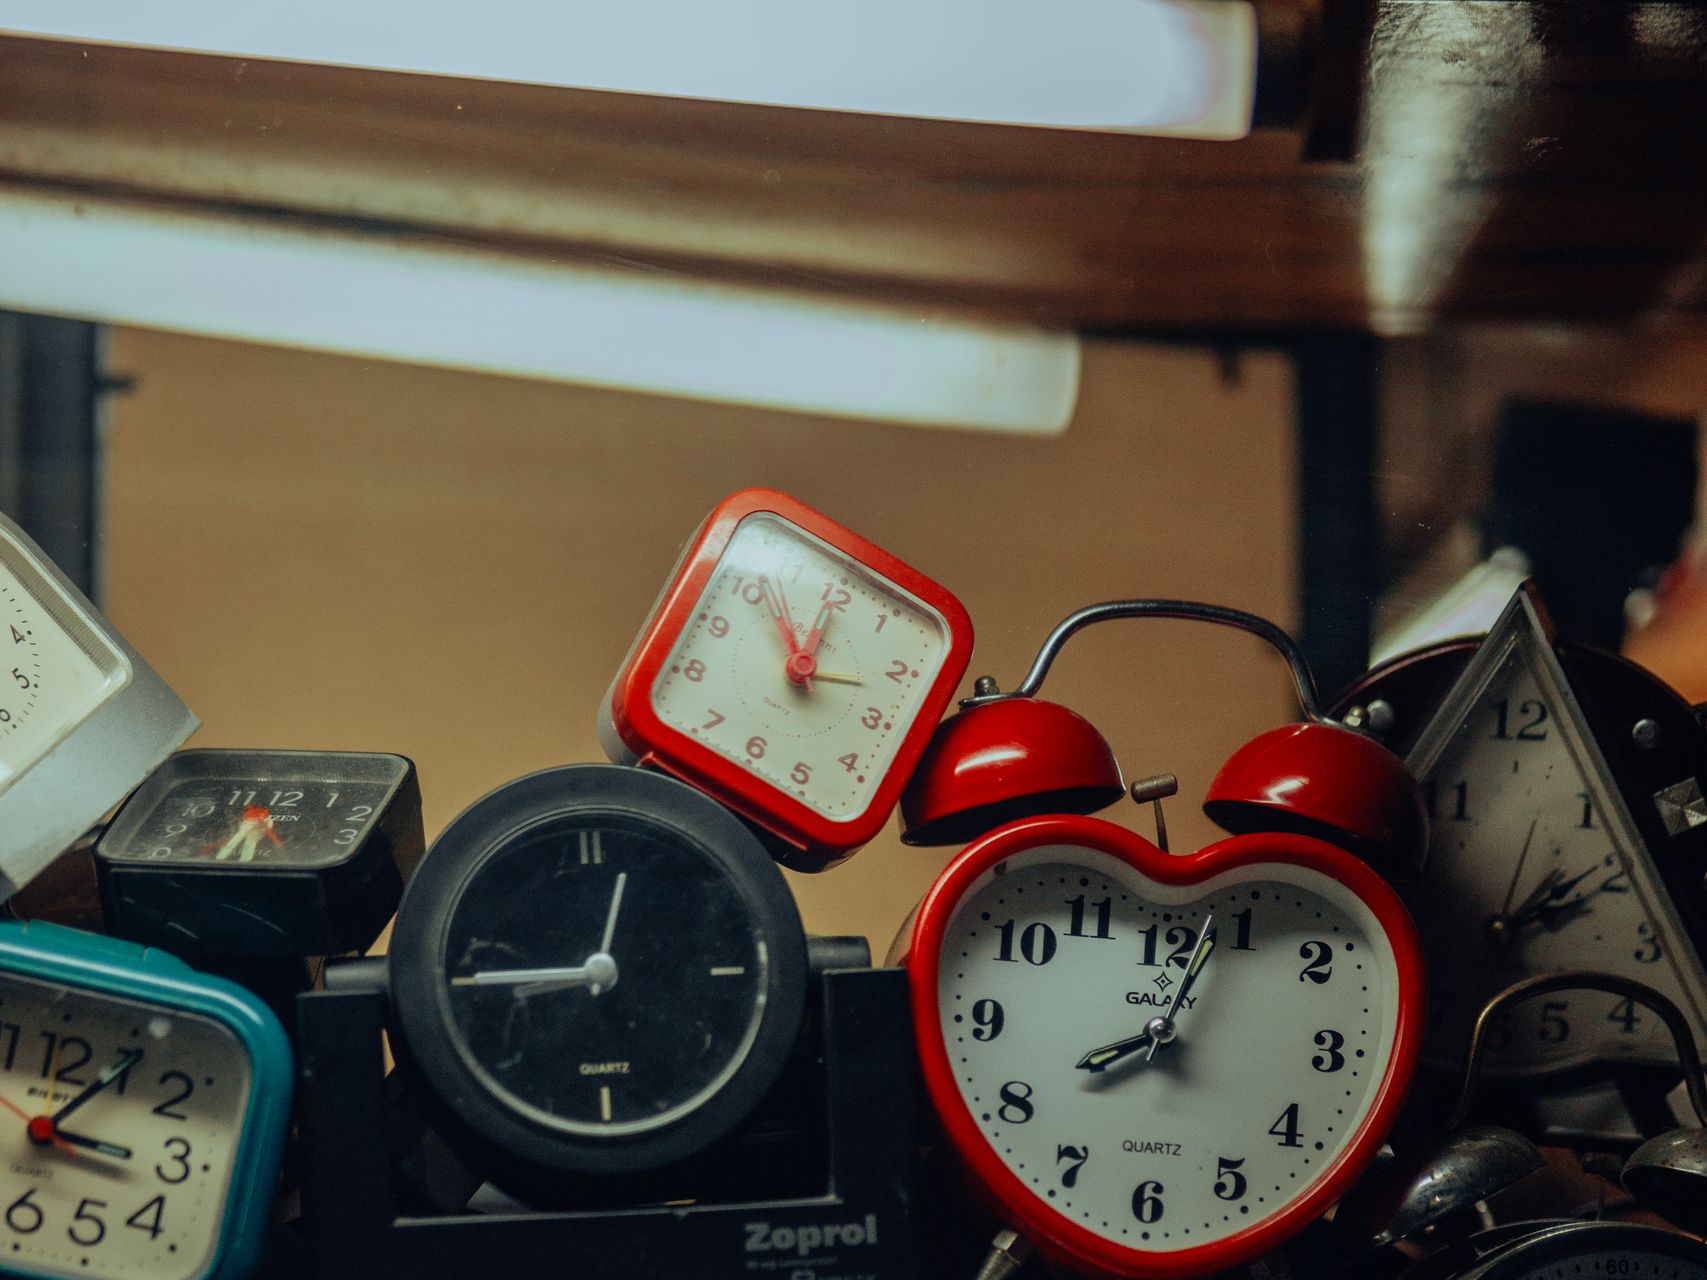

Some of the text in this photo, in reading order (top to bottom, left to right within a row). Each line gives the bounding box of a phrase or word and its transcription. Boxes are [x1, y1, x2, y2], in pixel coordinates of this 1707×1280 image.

[731, 575, 765, 605] 10
[820, 581, 853, 613] 12
[10, 624, 26, 644] 4
[708, 615, 730, 639] 9
[873, 613, 889, 634] 1
[11, 667, 30, 689] 5
[683, 658, 707, 682] 8
[885, 659, 908, 684] 2
[701, 708, 726, 731] 7
[861, 707, 884, 730] 3
[1491, 699, 1548, 741] 12
[745, 735, 768, 760] 6
[838, 752, 859, 773] 4
[790, 762, 814, 785] 5
[228, 790, 257, 806] 11
[269, 791, 304, 807] 12
[326, 792, 339, 808] 1
[345, 805, 372, 821] 2
[1575, 790, 1600, 829] 1
[165, 824, 187, 838] 9
[333, 828, 358, 844] 3
[1063, 893, 1117, 940] 11
[1230, 907, 1257, 951] 1
[992, 918, 1057, 966] 10
[1136, 924, 1199, 970] 12
[1633, 920, 1663, 964] 3
[1298, 940, 1334, 985] 2
[971, 998, 1005, 1042] 9
[1538, 1002, 1570, 1043] 5
[1606, 998, 1641, 1033] 4
[39, 1028, 93, 1087] 12
[579, 1061, 630, 1075] QUARTZ
[1311, 1029, 1345, 1073] 3
[153, 1070, 195, 1121] 2
[998, 1080, 1034, 1124] 8
[1267, 1102, 1305, 1148] 4
[156, 1137, 191, 1184] 3
[1056, 1143, 1089, 1189] 7
[1121, 1139, 1182, 1156] QUARTZ
[1213, 1156, 1248, 1201] 5
[6, 1187, 45, 1235] 6
[125, 1195, 166, 1240] 4
[1131, 1180, 1164, 1224] 6
[68, 1198, 108, 1247] 5
[744, 1213, 878, 1256] Zoprol
[1606, 1259, 1629, 1275] 60
